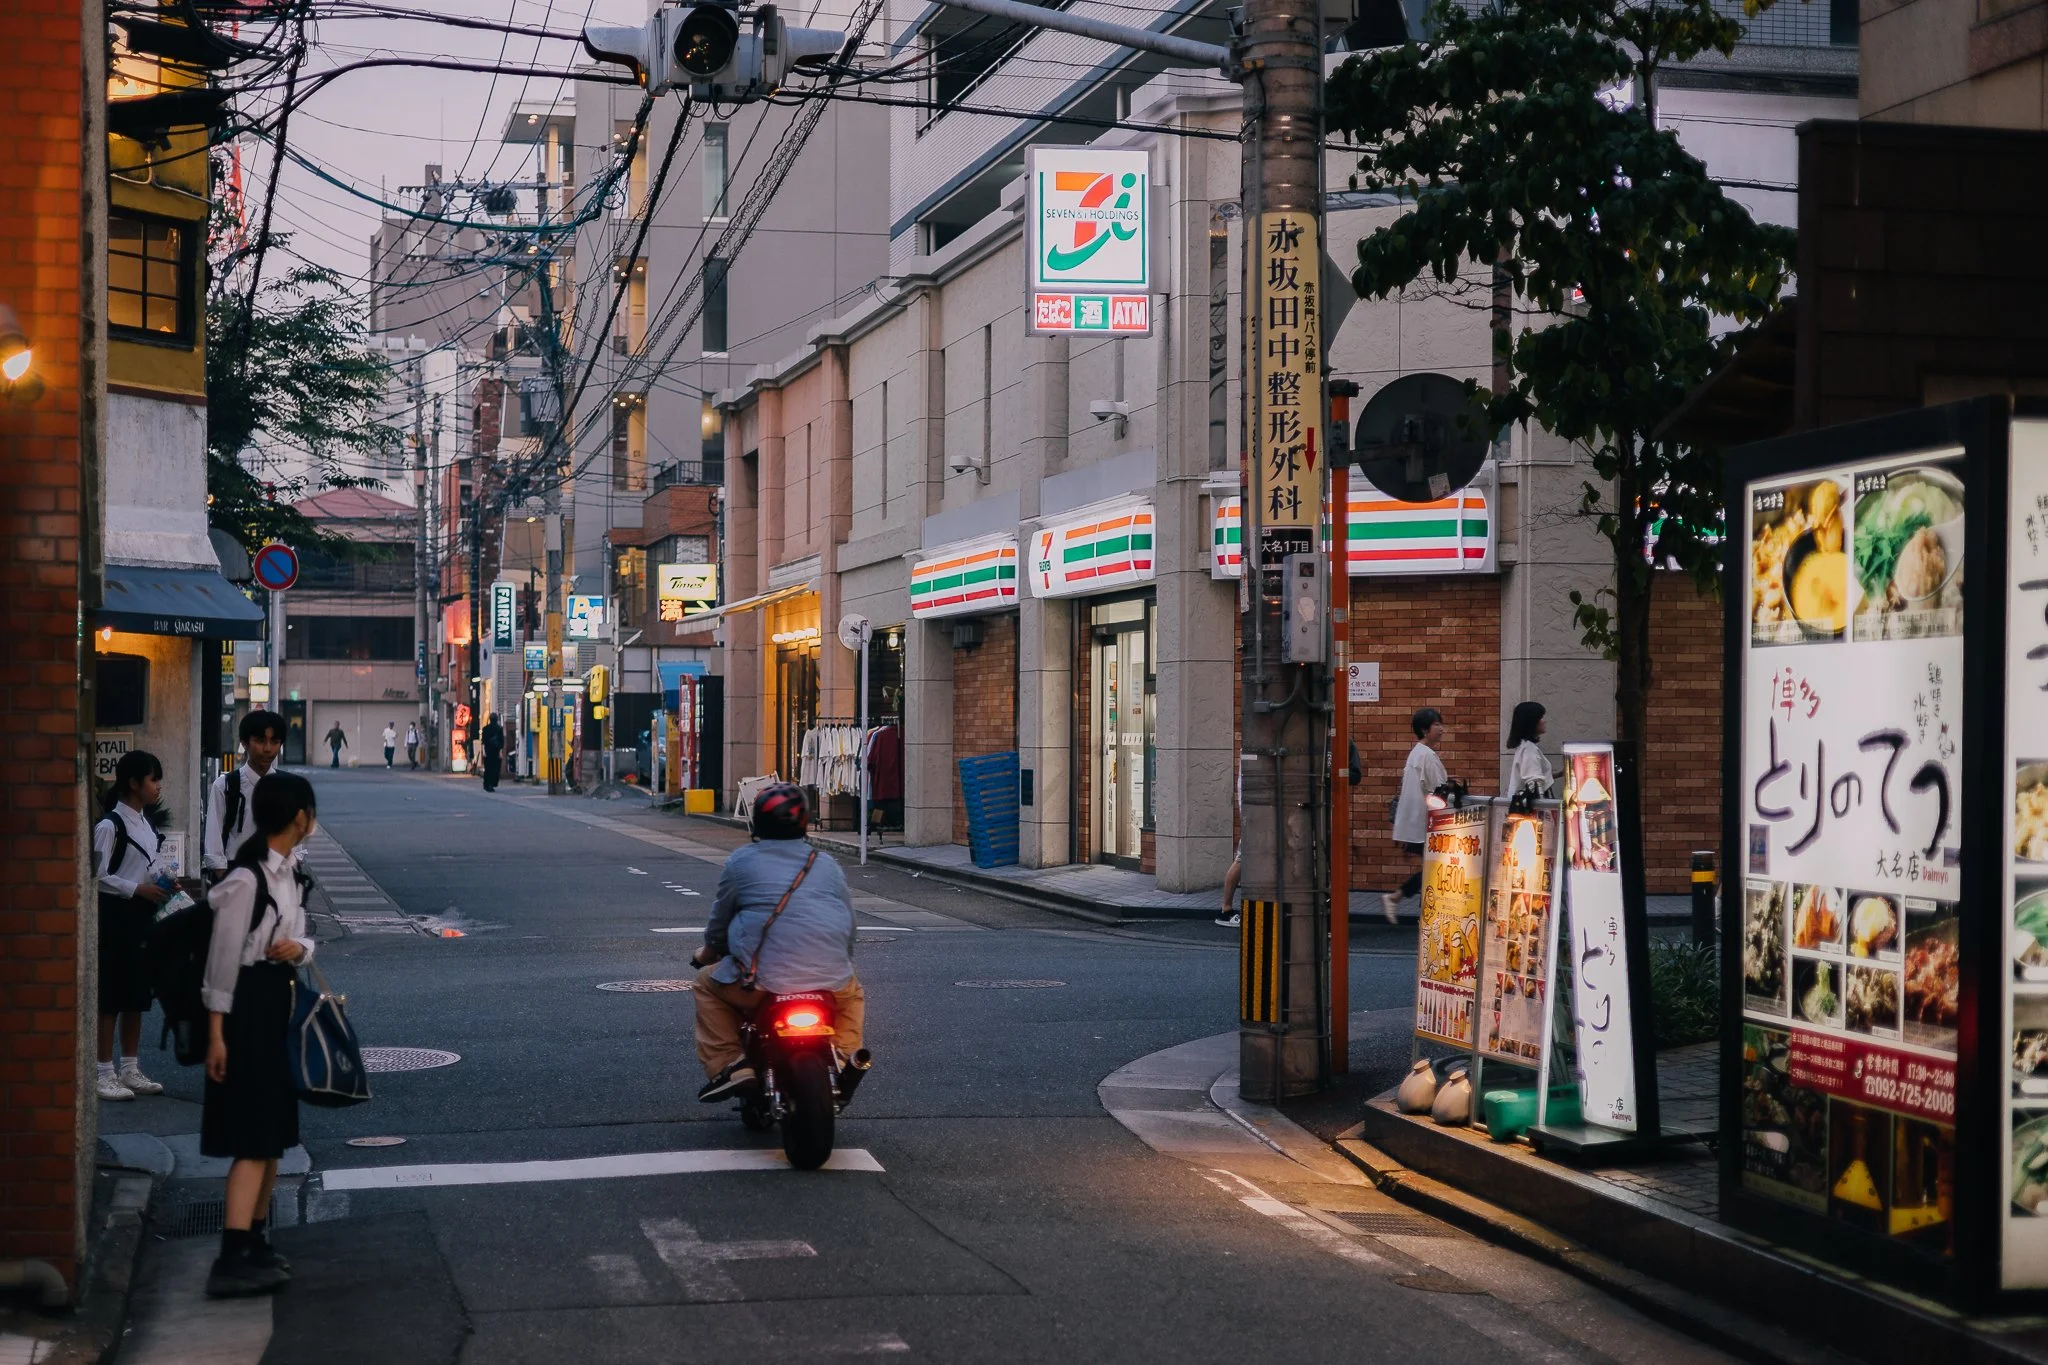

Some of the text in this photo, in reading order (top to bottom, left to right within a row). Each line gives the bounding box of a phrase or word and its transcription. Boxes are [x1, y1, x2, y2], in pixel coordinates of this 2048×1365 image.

[1090, 209, 1139, 221] HOLDINGS
[1037, 299, 1071, 324] たばこ
[1080, 300, 1104, 326] 酒
[1113, 301, 1146, 325] ATM
[1304, 281, 1316, 374] 赤坂門バス停前
[670, 576, 708, 589] Times
[154, 620, 168, 632] BAR
[497, 588, 510, 639] FAIRFAX
[1771, 667, 1821, 721] 博多
[1875, 848, 1920, 883] 大名店
[775, 993, 825, 1003] HONDA
[1866, 1053, 1899, 1077] 営業時間
[1875, 1076, 1955, 1115] 092-725-2008
